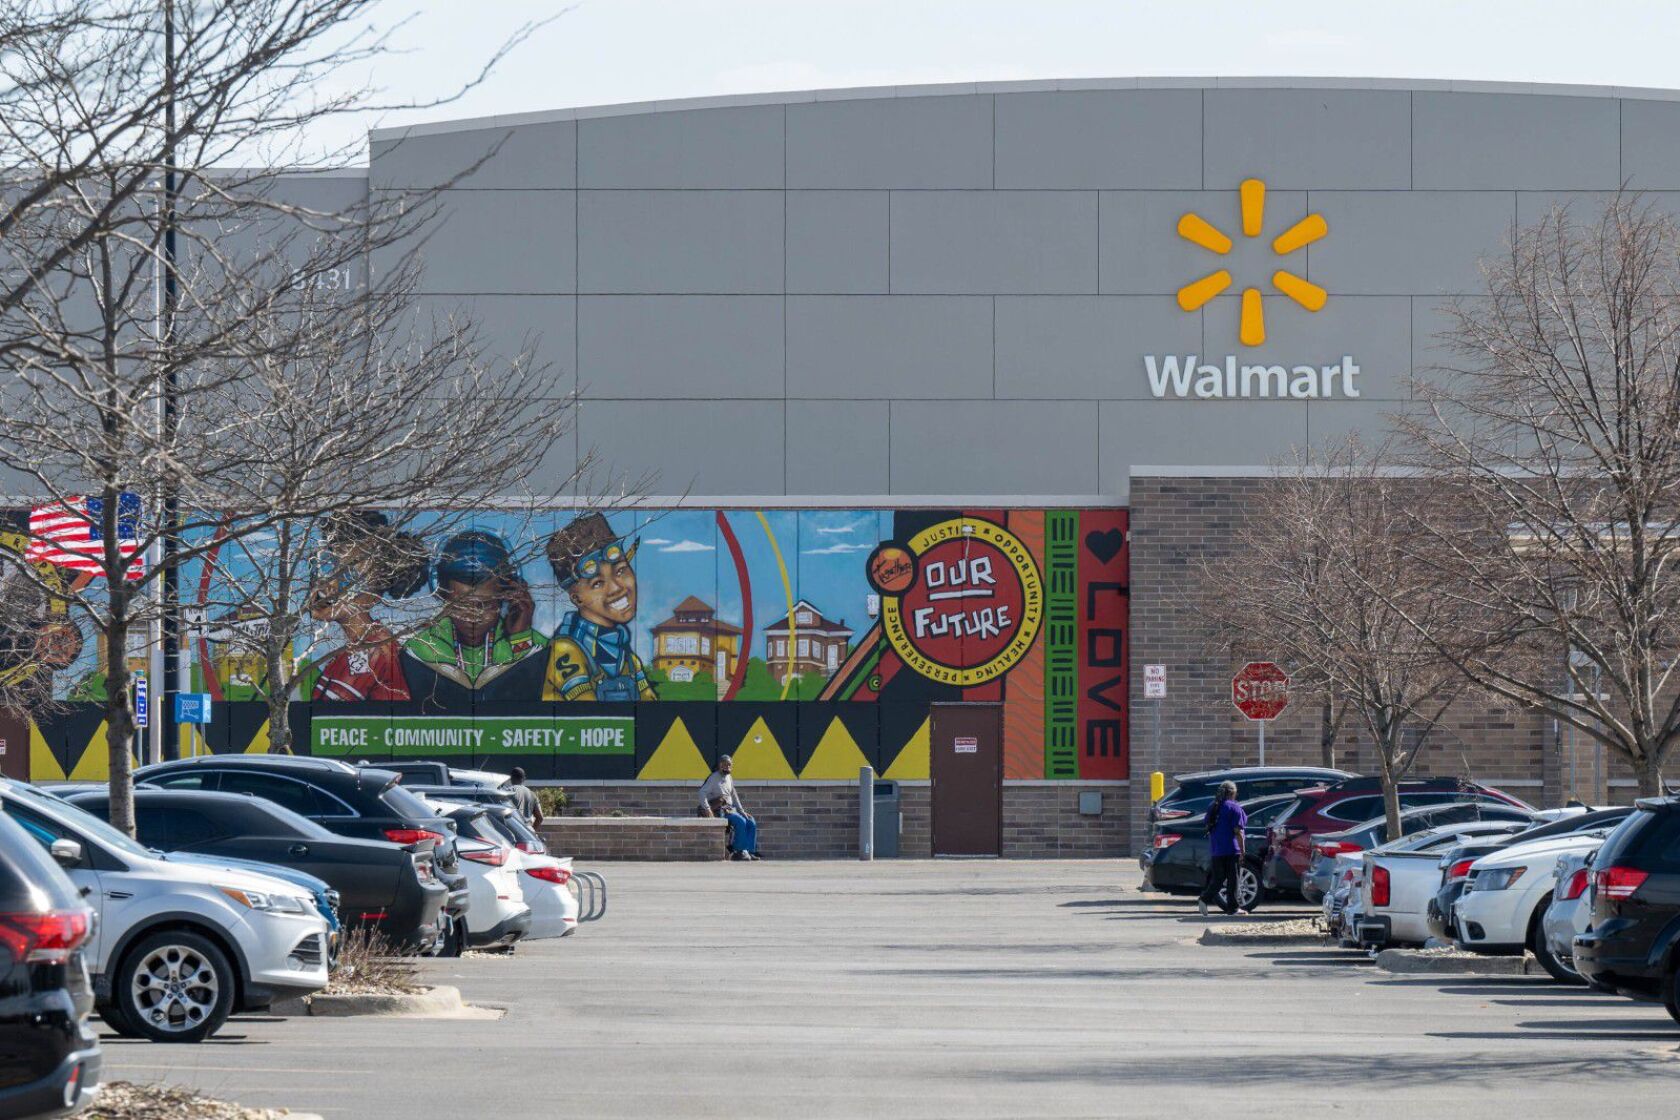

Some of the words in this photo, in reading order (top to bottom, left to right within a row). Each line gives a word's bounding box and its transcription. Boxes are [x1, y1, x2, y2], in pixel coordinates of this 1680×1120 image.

[1144, 355, 1360, 398] Walmart
[923, 524, 977, 547] JUSTIE
[925, 556, 997, 588] OUR
[994, 533, 1039, 624] OPPORTUNITY
[914, 605, 1012, 640] FUTURE
[887, 606, 958, 682] PERSEVERANCE
[975, 640, 1026, 679] HEALING
[1086, 582, 1122, 757] LOVE
[320, 728, 368, 746] PEACE
[384, 728, 484, 747] COMMUNITY
[502, 728, 564, 747] SAFETY
[580, 728, 625, 747] HOPE
